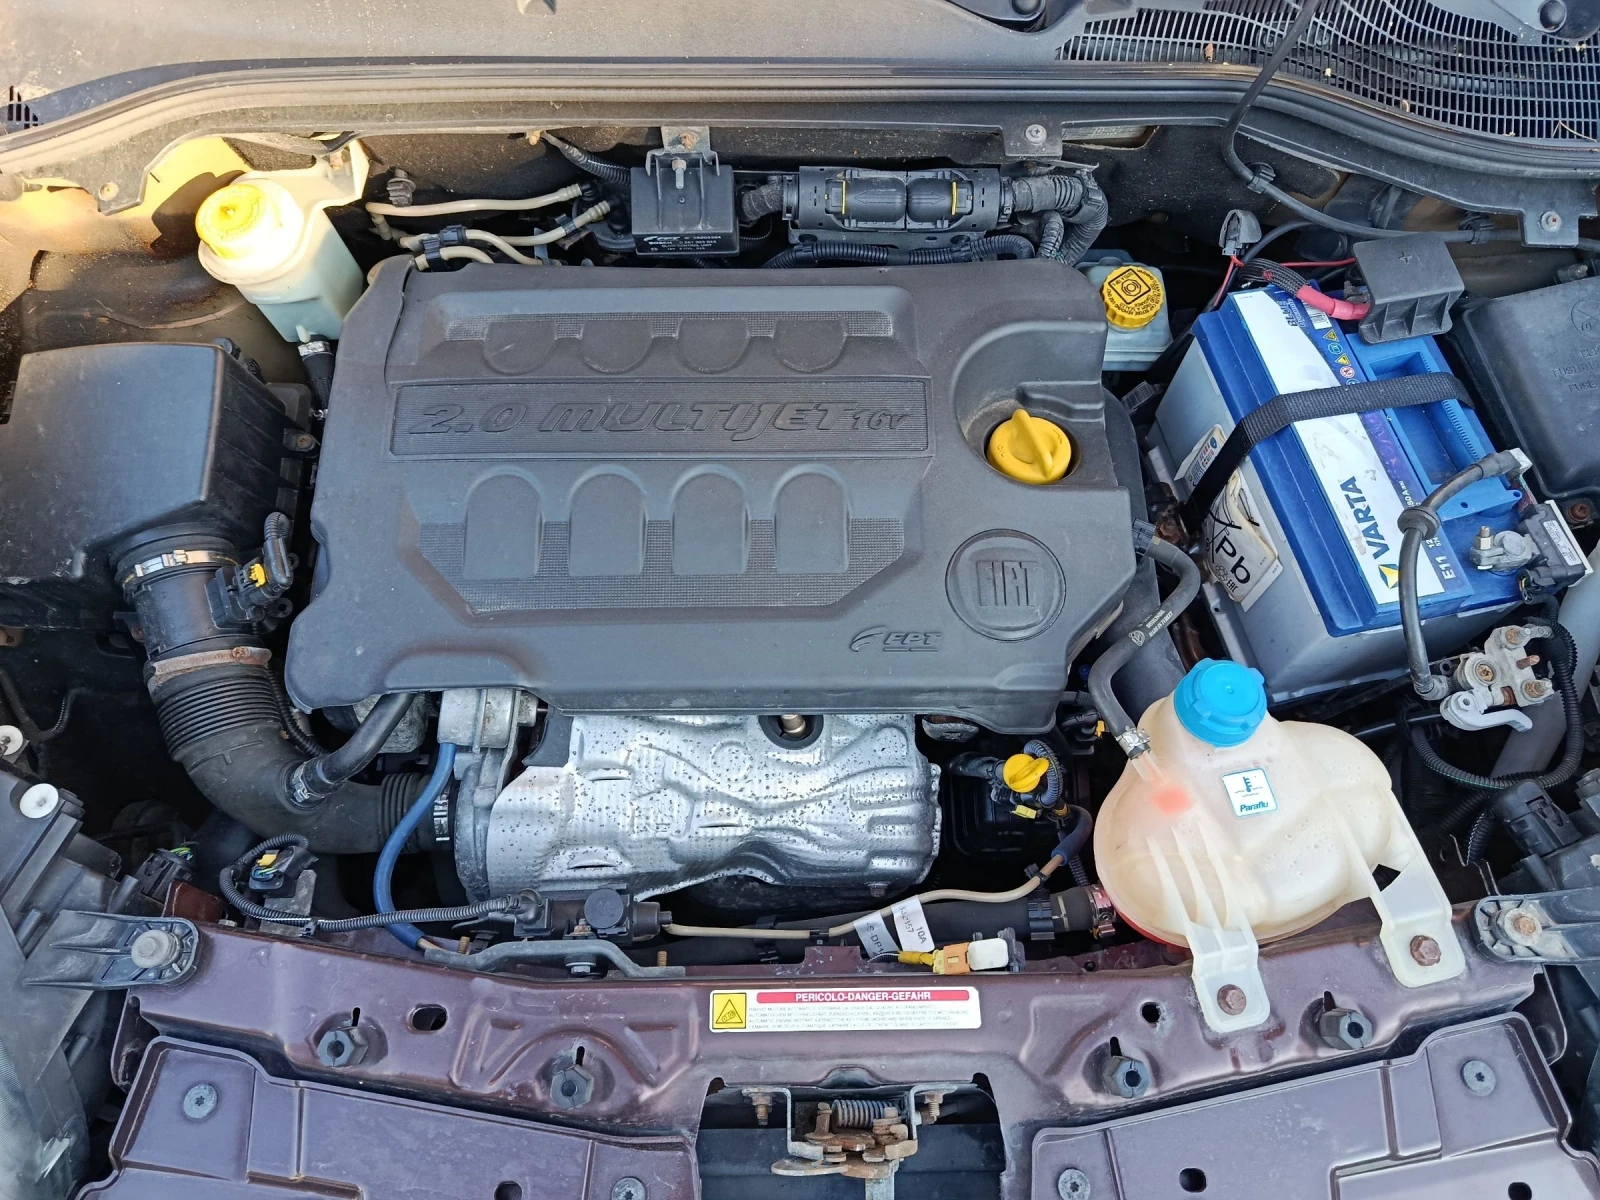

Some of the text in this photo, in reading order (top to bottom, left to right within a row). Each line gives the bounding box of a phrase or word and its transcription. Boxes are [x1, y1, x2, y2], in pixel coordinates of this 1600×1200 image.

[1275, 300, 1298, 327] BLUE
[409, 402, 529, 434] 2.0
[537, 401, 860, 442] MULTIJET
[1339, 476, 1390, 560] VARTA
[1215, 535, 1251, 584] Pb
[1435, 555, 1456, 580] E11
[975, 559, 1040, 607] FIAT
[1226, 578, 1239, 593] EAC
[882, 631, 943, 646] FPT
[1239, 800, 1269, 812] Paraflu
[795, 991, 931, 1002] PERICOLO-DANGER-GEFAHR
